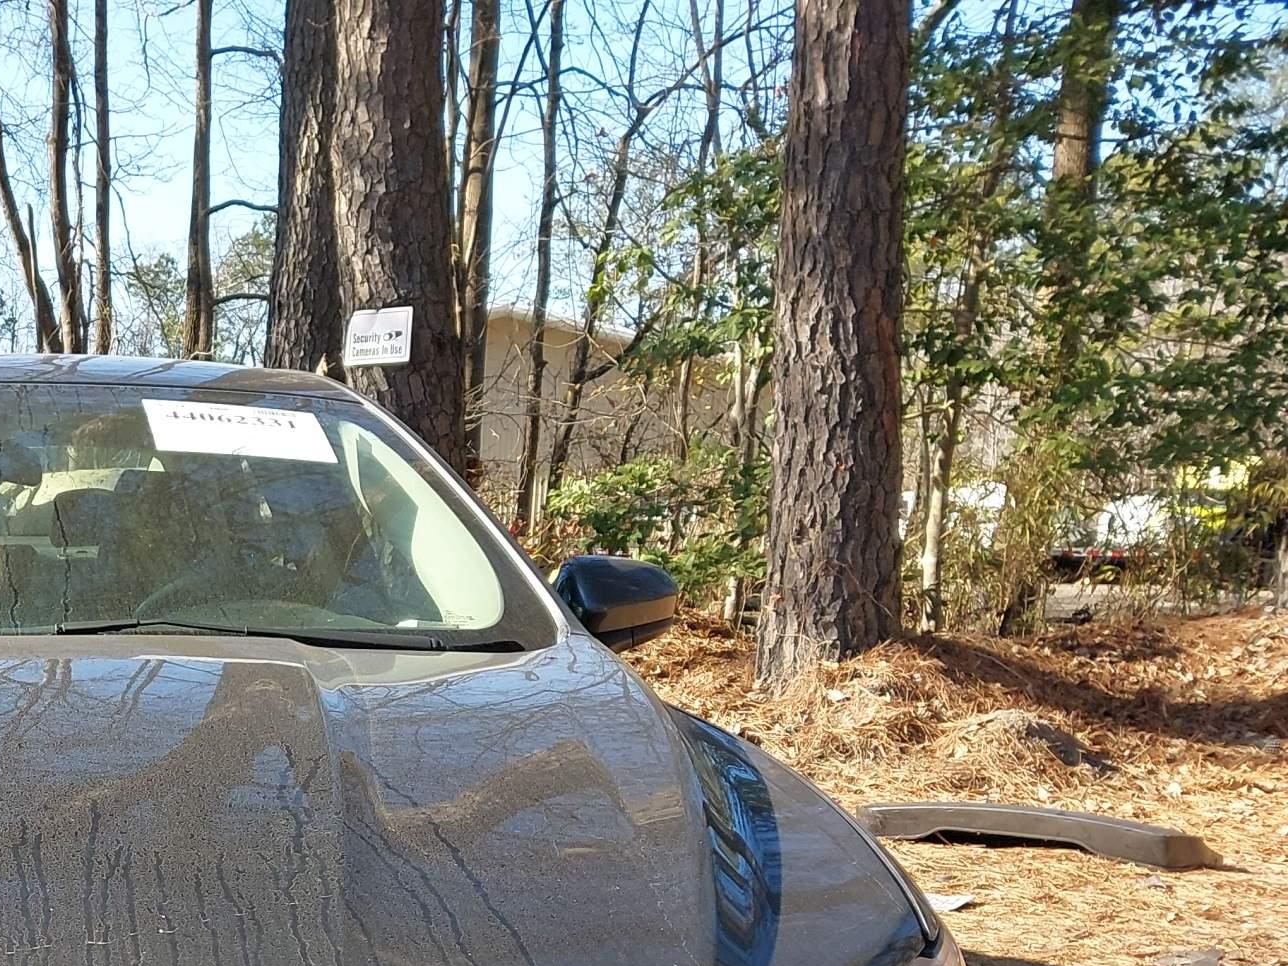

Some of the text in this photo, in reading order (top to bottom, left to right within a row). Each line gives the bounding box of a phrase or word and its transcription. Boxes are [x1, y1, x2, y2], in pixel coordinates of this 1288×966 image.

[352, 332, 381, 344] Security
[351, 346, 380, 357] Cameras
[390, 343, 403, 354] Use
[165, 410, 297, 431] 44062331
